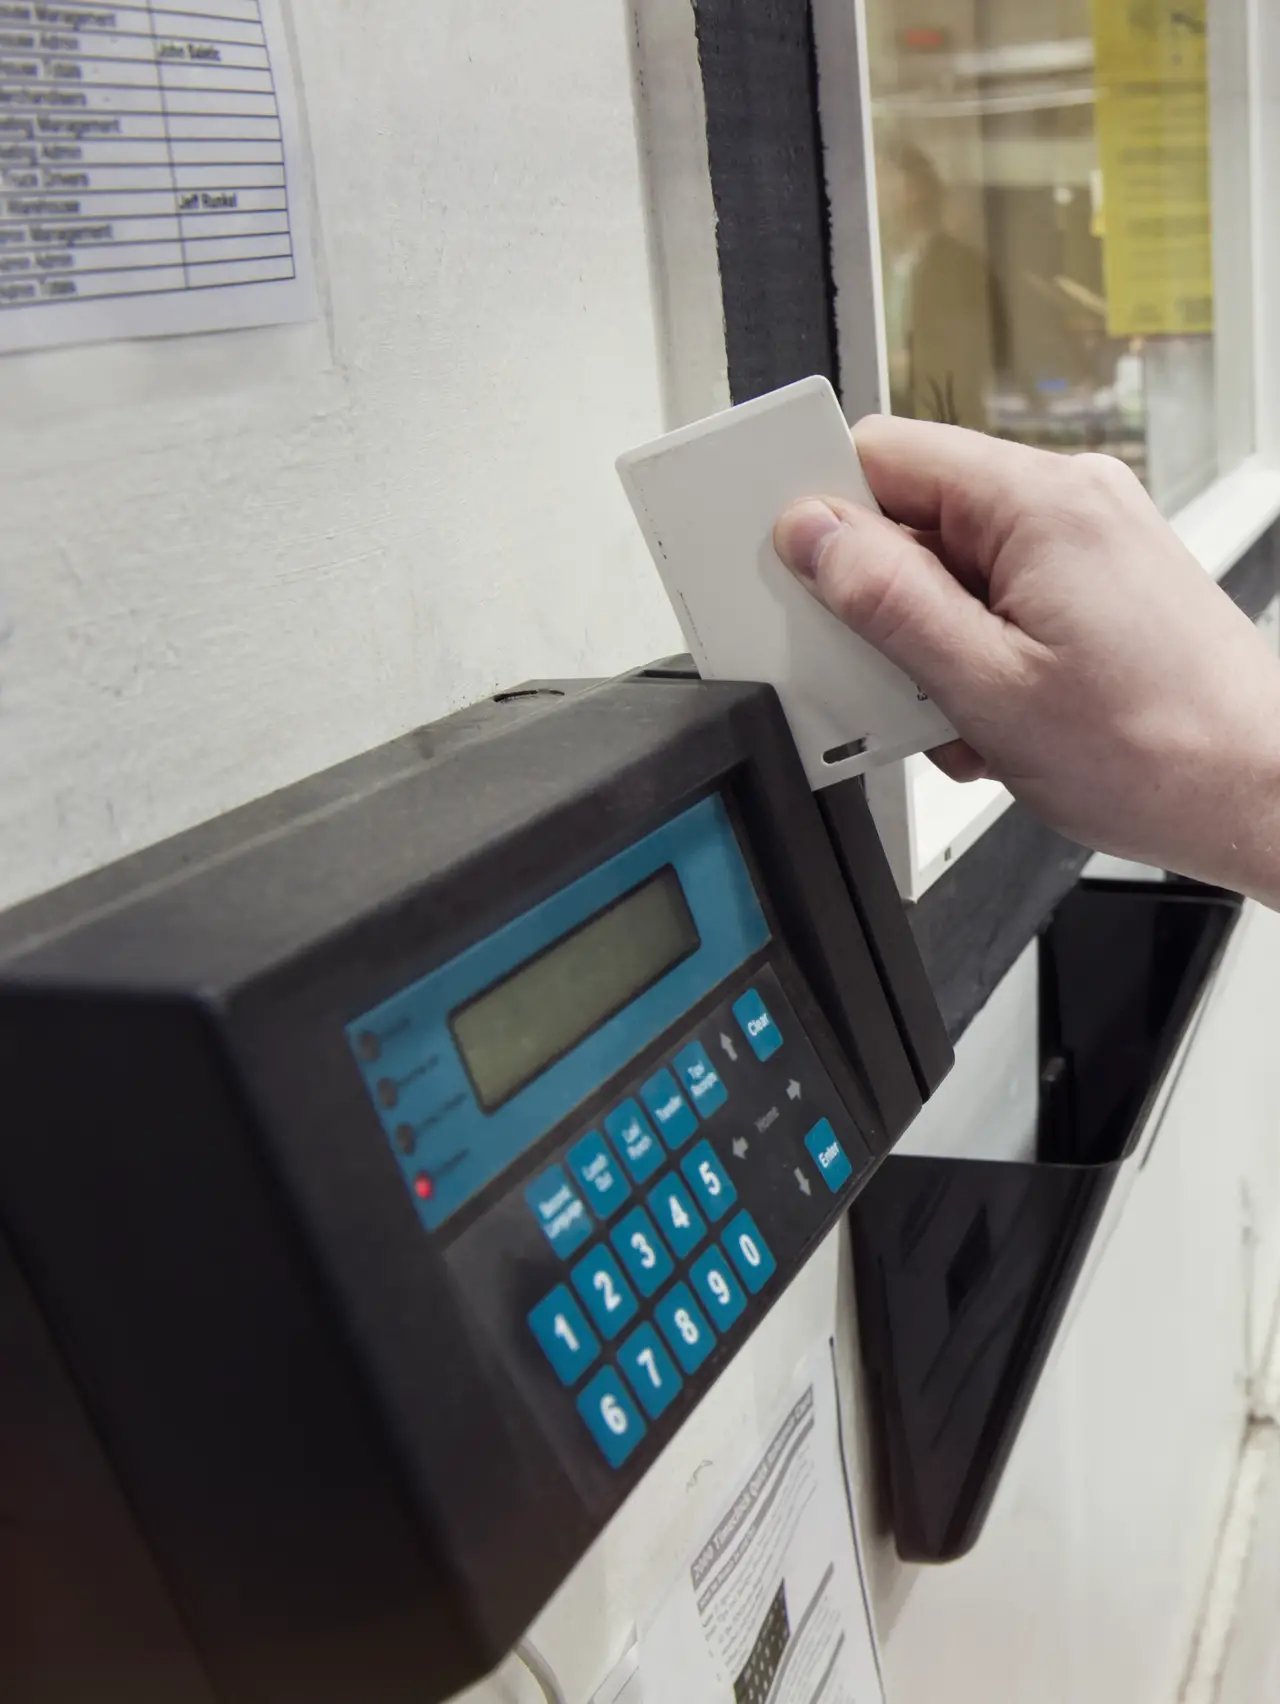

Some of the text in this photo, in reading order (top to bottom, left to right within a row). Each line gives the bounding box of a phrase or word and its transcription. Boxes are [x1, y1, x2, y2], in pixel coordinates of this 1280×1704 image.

[179, 192, 199, 209] Jeff
[748, 1013, 771, 1037] Clear
[754, 1106, 780, 1133] Home
[818, 1141, 840, 1169] Enter
[700, 1162, 720, 1195] 5
[670, 1197, 689, 1226] 4
[632, 1233, 655, 1267] 3
[740, 1235, 760, 1265] 0
[595, 1272, 620, 1309] 2
[708, 1271, 729, 1303] 9
[556, 1316, 578, 1349] 1
[675, 1309, 698, 1343] 8
[638, 1349, 660, 1386] 7
[601, 1396, 627, 1433] 6
